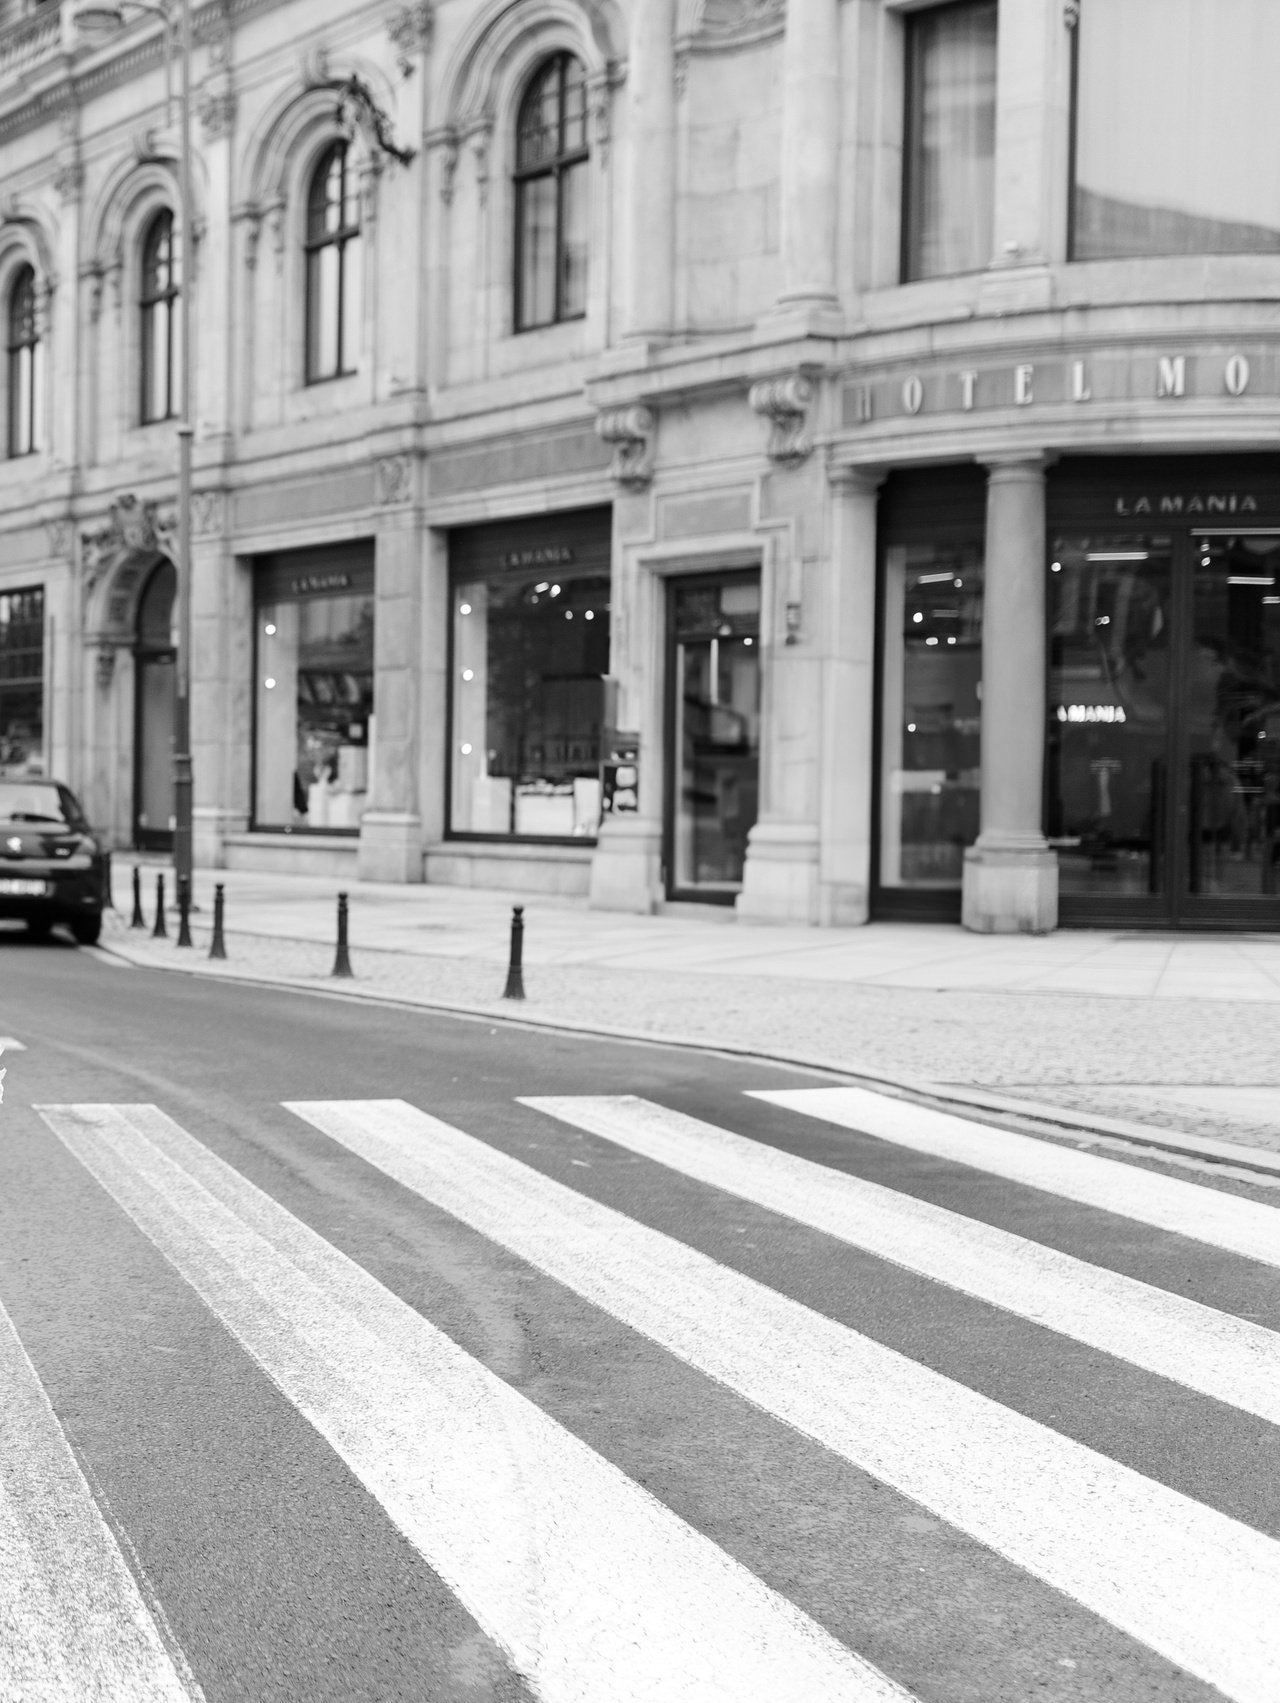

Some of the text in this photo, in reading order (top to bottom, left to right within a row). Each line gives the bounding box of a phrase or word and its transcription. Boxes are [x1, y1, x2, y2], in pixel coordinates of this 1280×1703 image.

[856, 353, 1250, 421] HOTEL MO
[1116, 494, 1258, 516] LA MANIA
